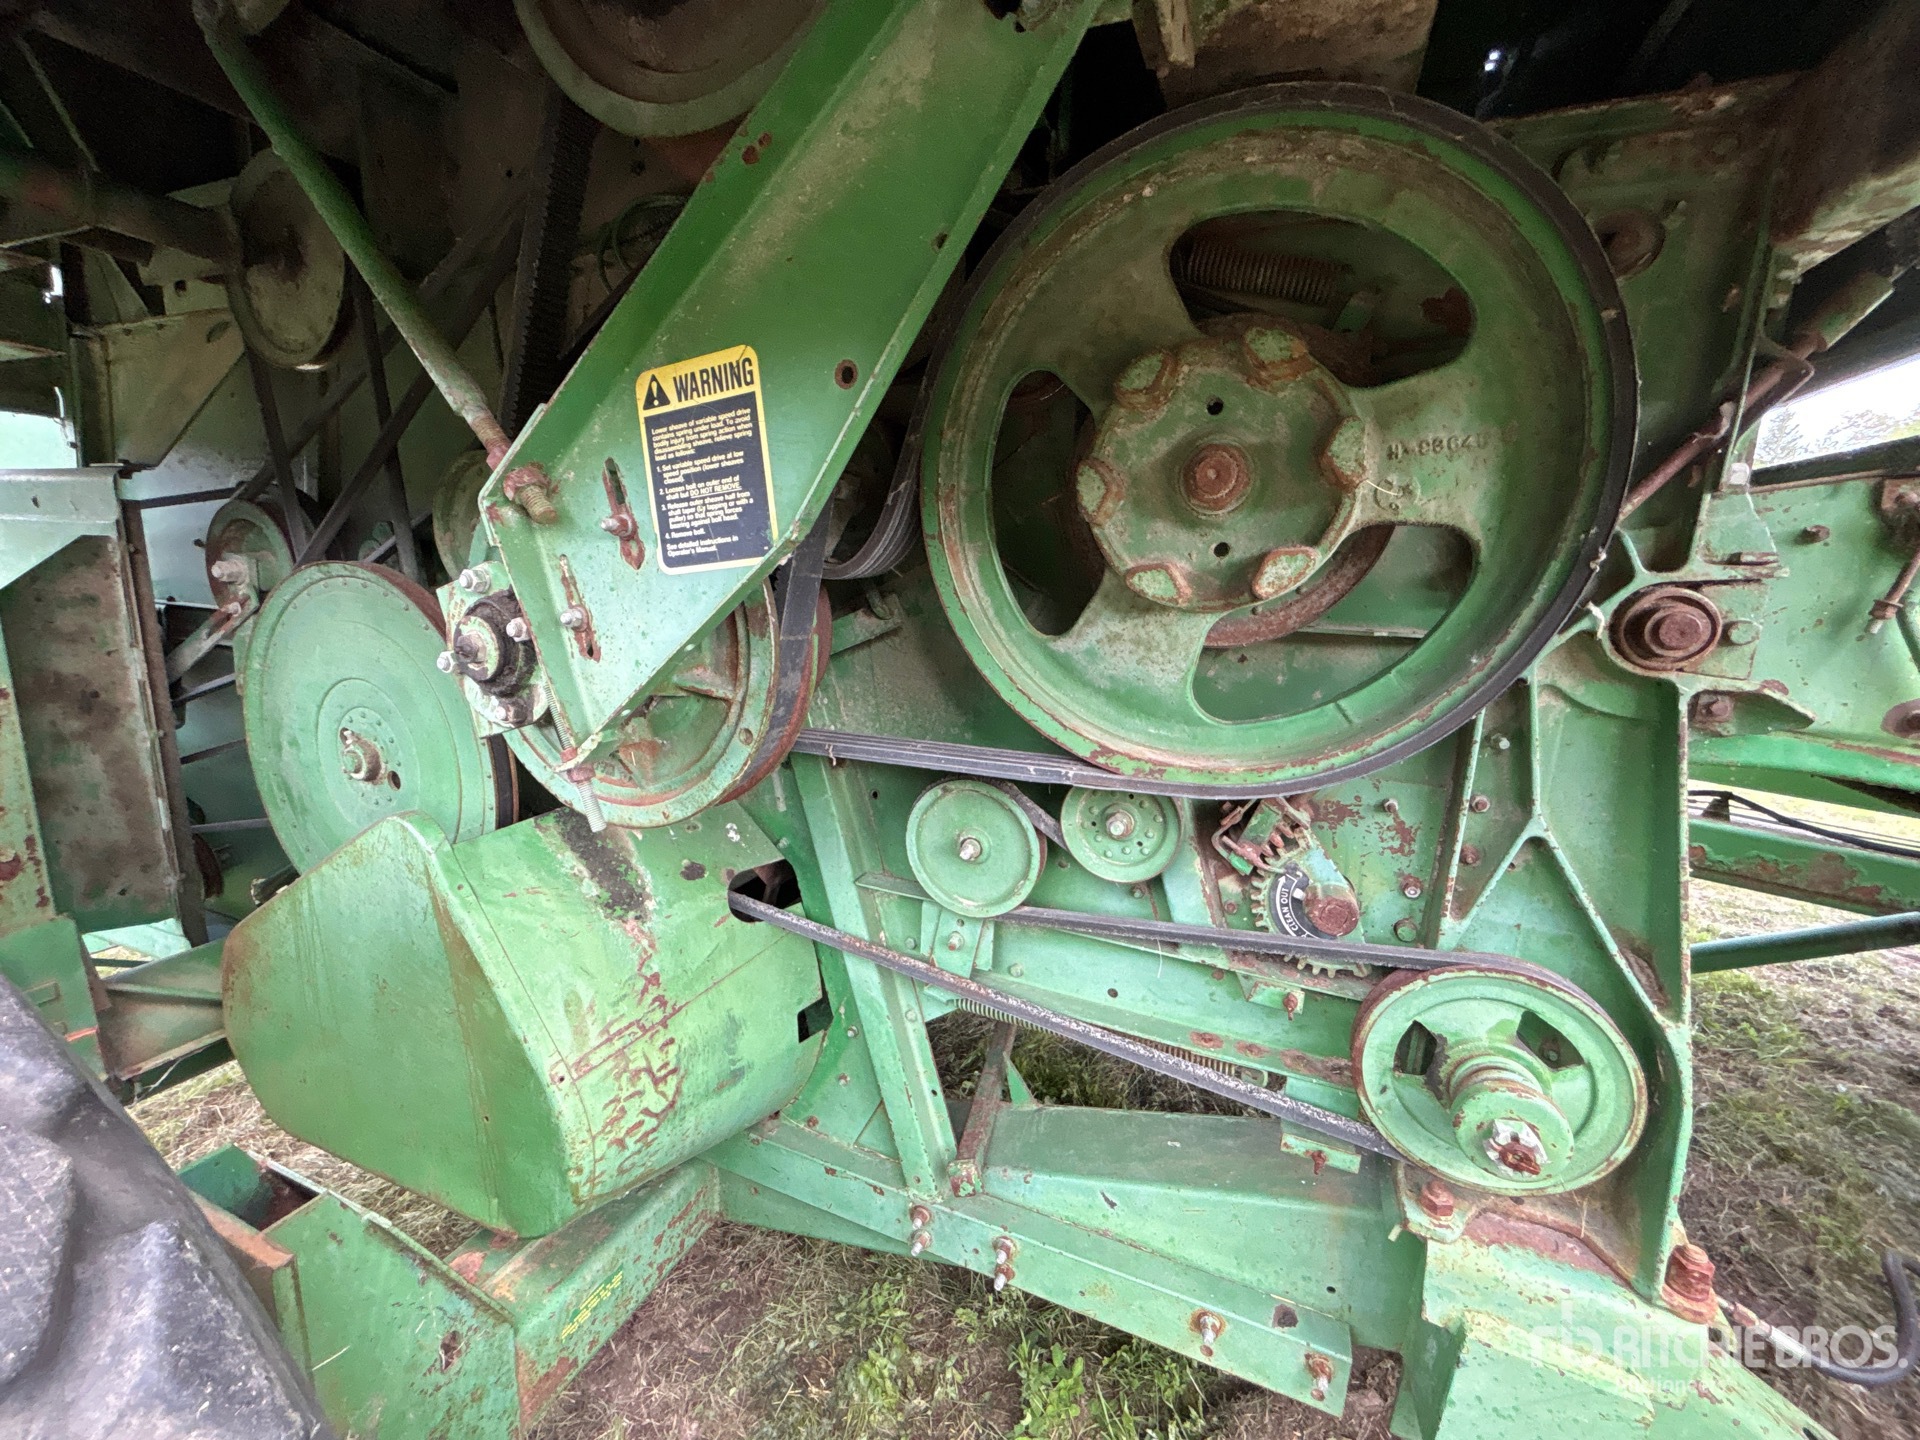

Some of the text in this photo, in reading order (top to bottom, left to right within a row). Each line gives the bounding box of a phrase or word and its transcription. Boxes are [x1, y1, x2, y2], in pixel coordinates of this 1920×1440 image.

[673, 357, 755, 402] WARNING
[652, 427, 667, 435] Lower
[669, 423, 687, 431] sheave
[696, 416, 717, 425] variable
[718, 410, 736, 420] speed
[653, 433, 675, 441] contains
[676, 429, 693, 437] spring
[694, 424, 710, 432] under
[735, 415, 751, 423] avoid
[653, 440, 669, 448] bodily
[700, 430, 717, 438] spring
[719, 426, 736, 434] action
[714, 434, 733, 442] relieve
[734, 430, 752, 438] spring
[663, 458, 744, 479] speed position (lower sheaves
[672, 461, 693, 469] variable
[694, 457, 711, 465] speed
[665, 486, 685, 494] Loosen
[714, 482, 742, 491] REMOVE.
[707, 503, 728, 511] tapping
[707, 510, 724, 518] spring
[691, 518, 711, 527] against
[678, 540, 699, 549] detailed
[700, 537, 732, 545] instructions
[1281, 888, 1299, 930] CLEAN OUT
